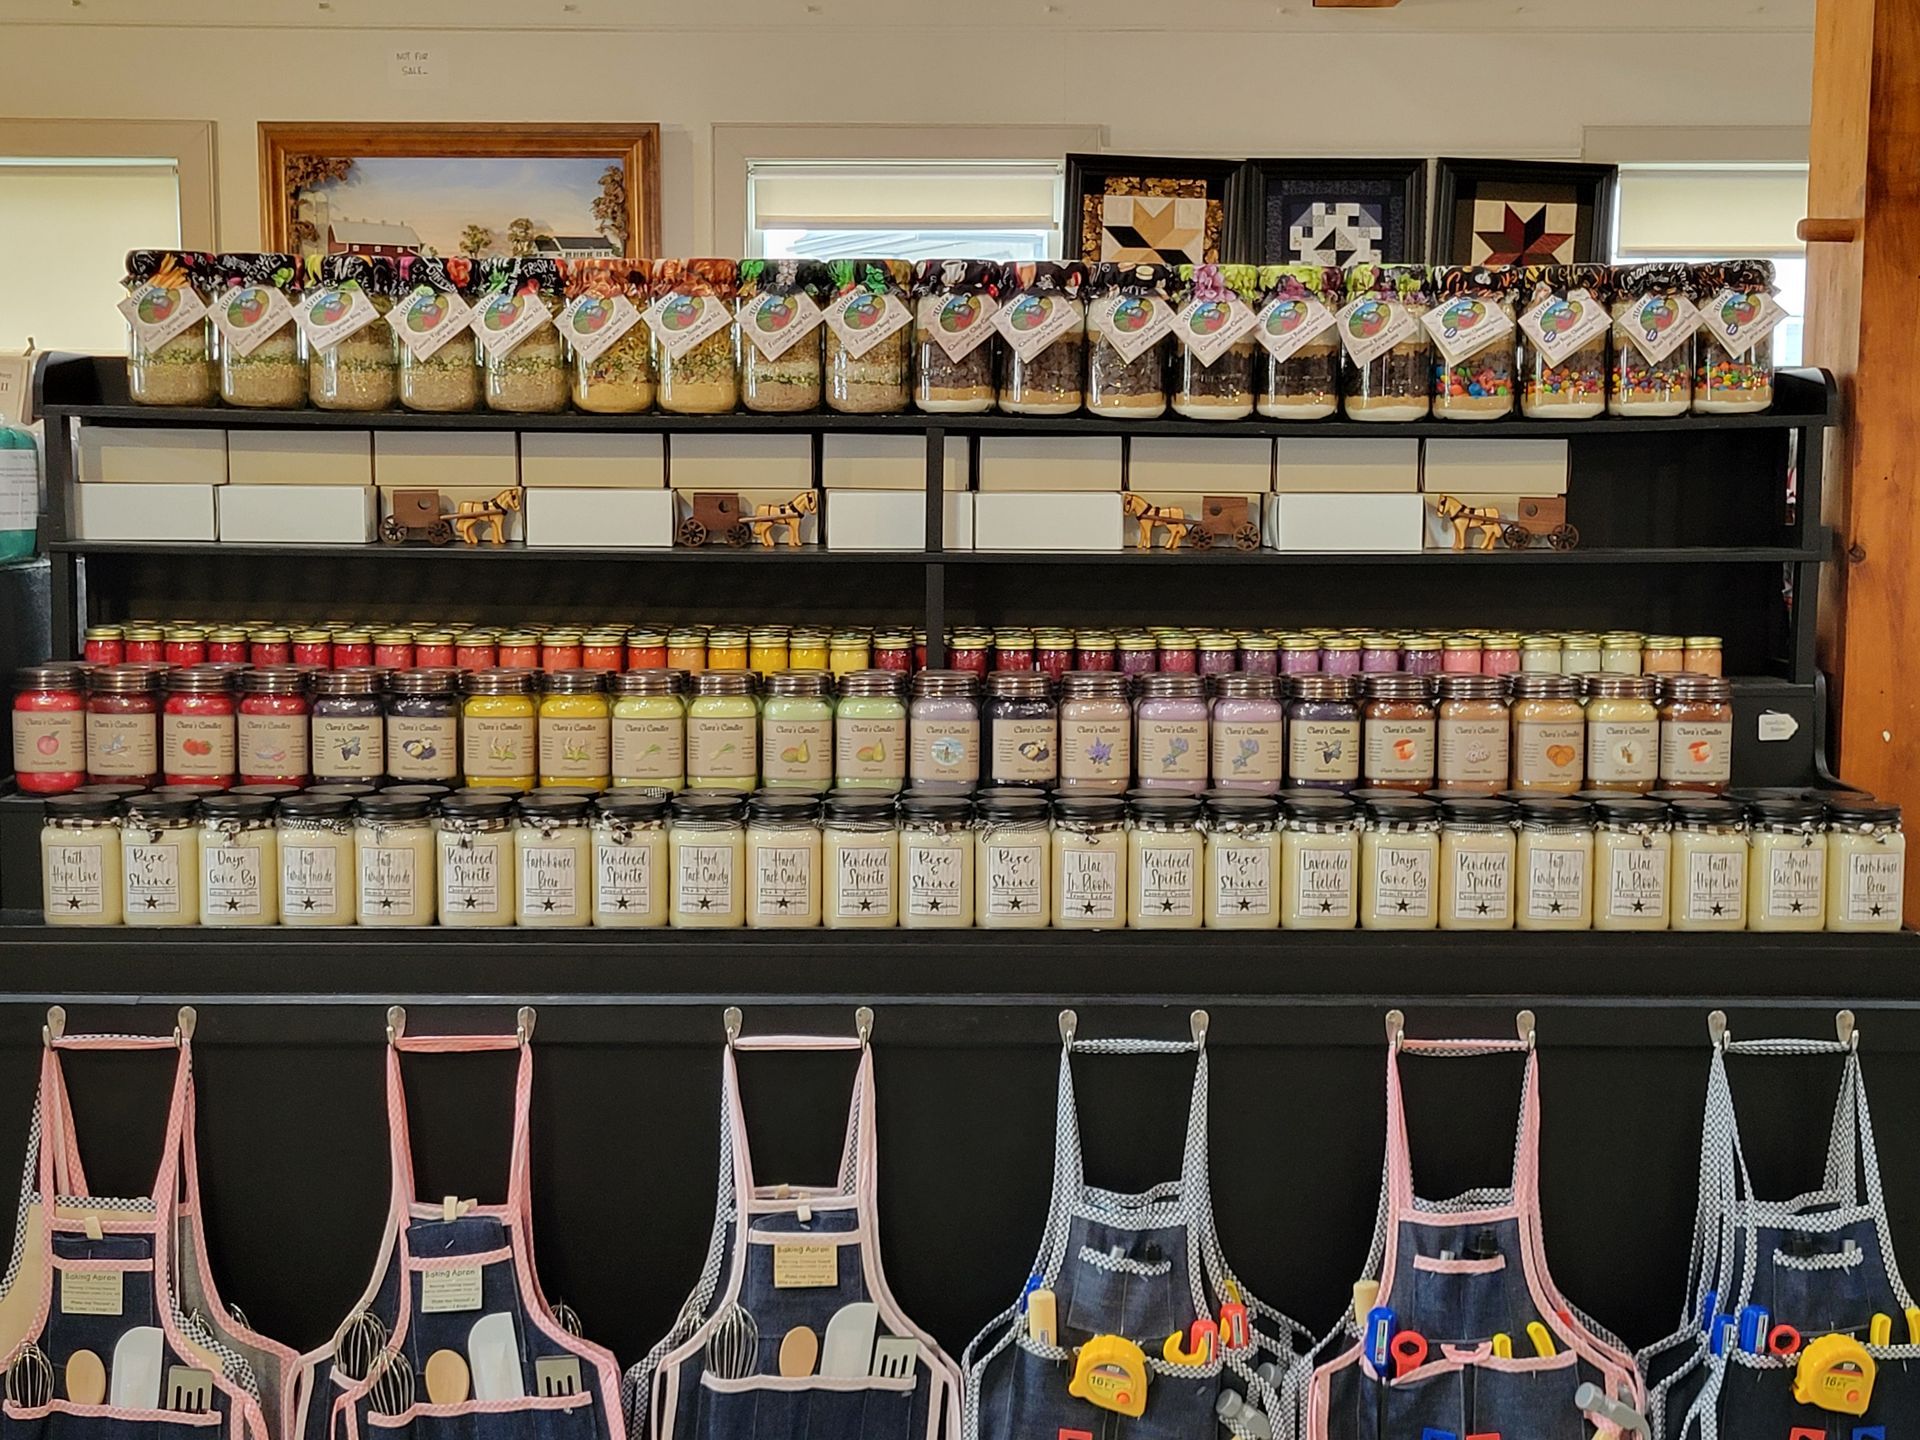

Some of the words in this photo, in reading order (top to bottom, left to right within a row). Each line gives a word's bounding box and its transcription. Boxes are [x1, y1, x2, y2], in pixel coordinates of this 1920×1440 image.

[25, 717, 46, 726] Clara's
[94, 720, 114, 728] Clara's
[176, 721, 197, 729] Clara's
[198, 721, 221, 729] Candles
[248, 722, 268, 730] Clara's
[325, 723, 346, 731] Clara's
[398, 723, 419, 731] Clara's
[478, 723, 498, 731] Clara's
[552, 723, 572, 731] Clara's
[625, 724, 645, 732] Clara's
[700, 723, 719, 731] Clara's
[776, 725, 796, 733] Clara's
[851, 724, 871, 733] Clara's
[1014, 725, 1034, 733] Clara's
[1077, 725, 1097, 733] Clara's
[1154, 725, 1175, 733] Clara's
[926, 726, 946, 734] Clara's
[1225, 727, 1245, 735] Clara's
[1247, 727, 1268, 735] Candles
[1307, 726, 1327, 734] Clara's
[1383, 726, 1403, 734] Clara's
[1455, 726, 1475, 734] Clara's
[1540, 730, 1560, 738] Clara's
[1606, 727, 1626, 735] Clara's
[1677, 728, 1698, 736] Clara's
[63, 849, 83, 865] Faith
[133, 849, 166, 864] Rise
[218, 851, 244, 868] Days
[300, 850, 314, 865] Faith
[377, 852, 391, 866] Faith
[448, 848, 493, 865] Kindred
[600, 848, 646, 865] Kindred
[693, 850, 717, 865] Hard
[772, 851, 795, 866] Hard
[842, 851, 887, 867] Kindred
[919, 850, 952, 865] Rise
[999, 849, 1032, 864] Rise
[1144, 851, 1190, 868] Kindred
[1227, 851, 1261, 865] Rise
[1303, 851, 1347, 870] Lavender
[1391, 851, 1417, 869] Days
[1460, 853, 1505, 871] Kindred
[1550, 853, 1564, 869] Faith
[1708, 856, 1728, 872] Faith
[53, 868, 73, 885] Hope
[130, 874, 175, 887] Shine
[210, 869, 235, 884] Gone
[241, 870, 256, 887] By
[454, 865, 489, 886] Spirits
[538, 870, 558, 888] Brew
[607, 867, 642, 887] Spirits
[702, 867, 728, 887] Candy
[781, 868, 806, 886] Candy
[849, 868, 884, 889] Spirits
[912, 875, 958, 889] Shine
[993, 875, 1037, 889] Shine
[1151, 869, 1187, 889] Spirits
[1221, 875, 1266, 889] Shine
[1309, 872, 1341, 889] Fields
[1380, 870, 1407, 885] Gone
[1413, 872, 1426, 889] By
[1467, 872, 1501, 892] Spirits
[1774, 869, 1791, 885] Bake
[1694, 873, 1718, 895] Hope
[1866, 876, 1886, 893] Brew
